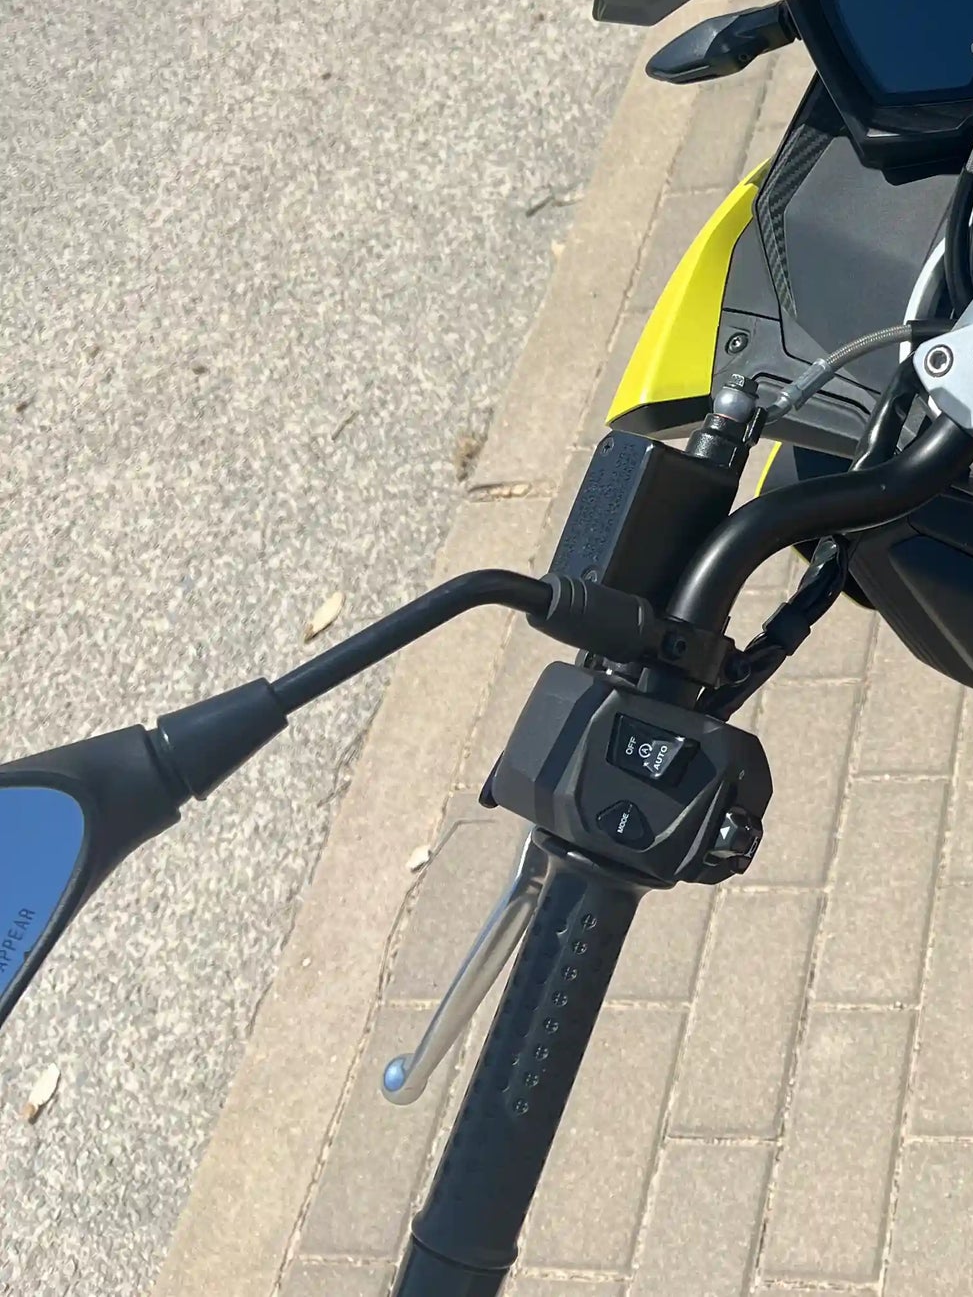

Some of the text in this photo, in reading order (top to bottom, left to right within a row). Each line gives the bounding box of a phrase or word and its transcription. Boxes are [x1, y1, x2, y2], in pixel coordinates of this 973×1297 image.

[625, 736, 637, 756] OFF
[653, 745, 668, 771] AUTO
[617, 812, 630, 834] MODE
